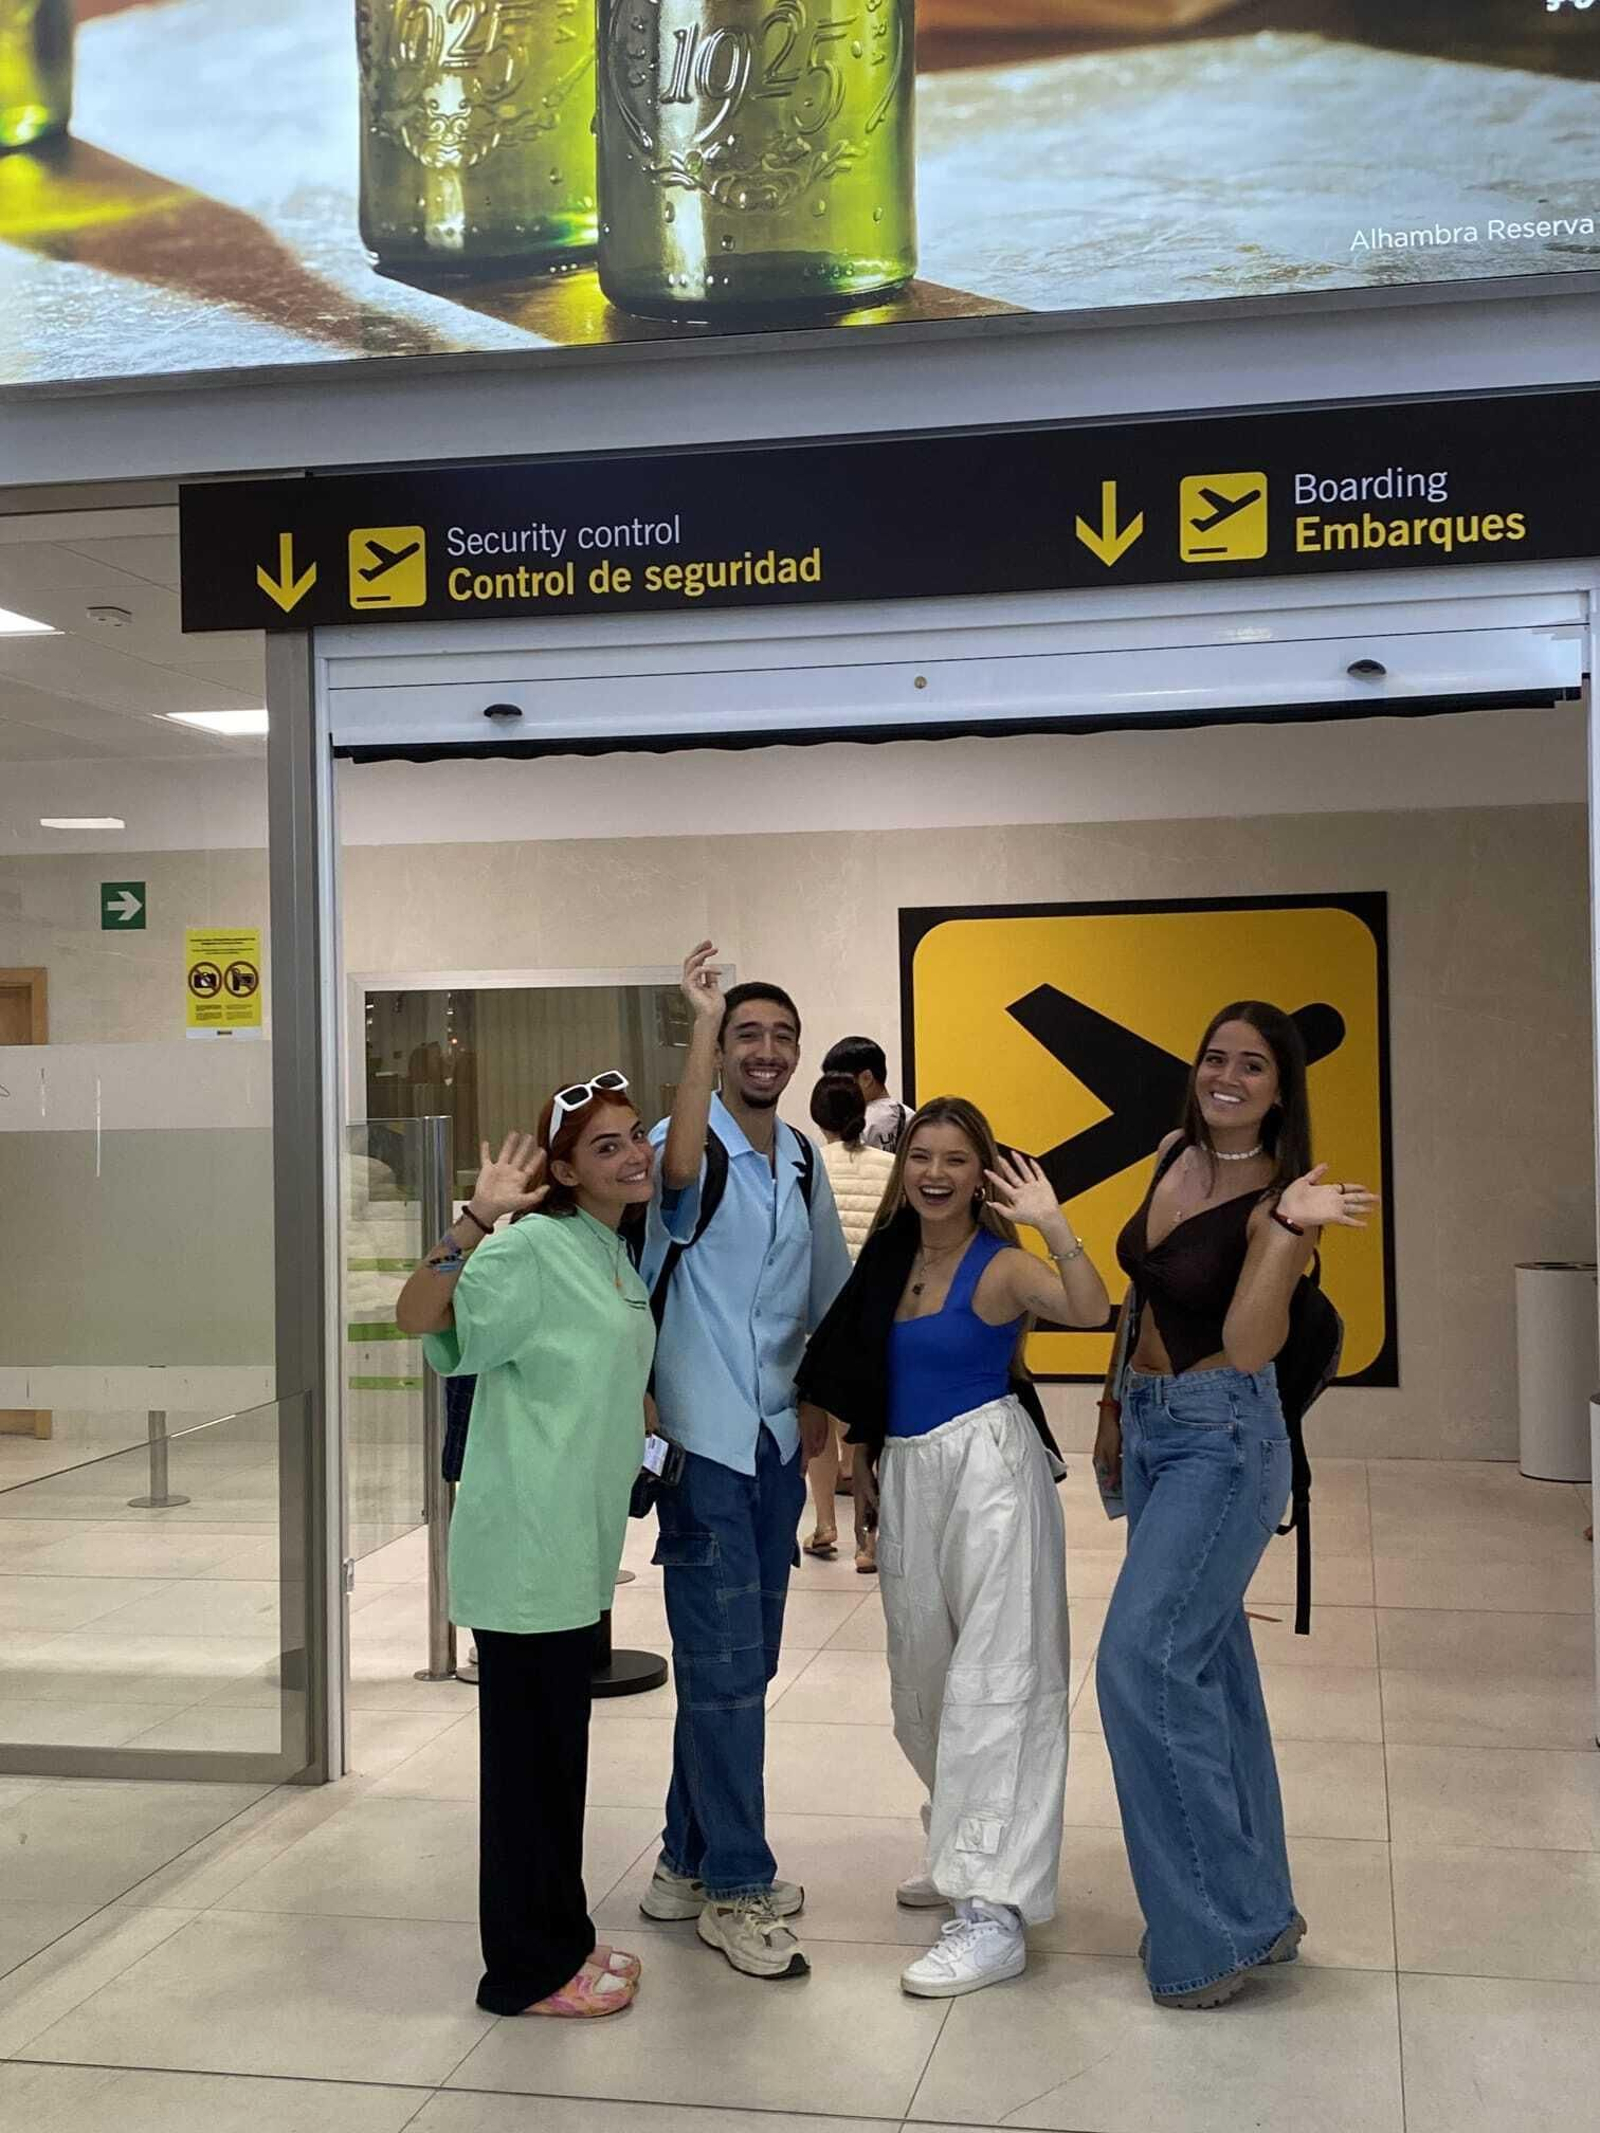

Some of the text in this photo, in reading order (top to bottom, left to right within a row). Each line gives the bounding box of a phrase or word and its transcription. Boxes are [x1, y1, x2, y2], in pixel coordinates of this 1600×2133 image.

[1350, 217, 1595, 252] Alhambra Reserva
[1294, 467, 1448, 505] Boarding
[446, 514, 681, 558] Security control
[1296, 513, 1526, 552] Embarques
[448, 547, 822, 601] Control de seguridad
